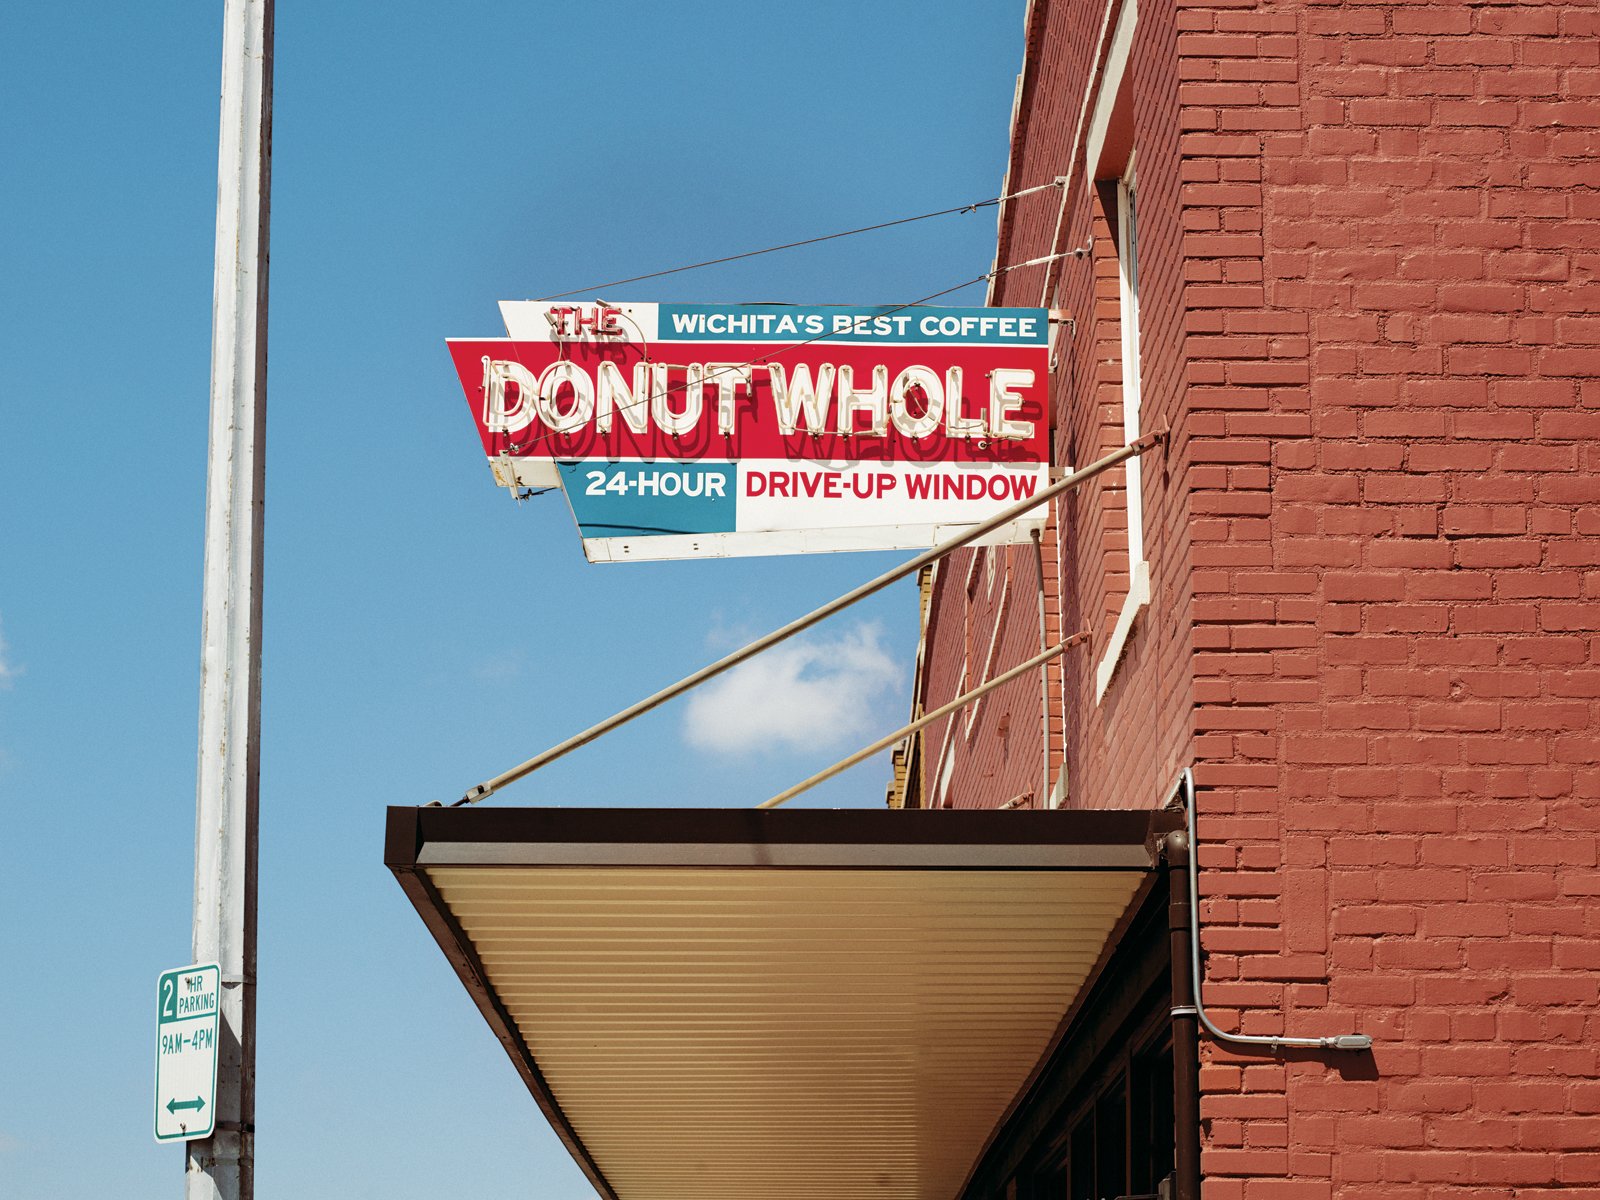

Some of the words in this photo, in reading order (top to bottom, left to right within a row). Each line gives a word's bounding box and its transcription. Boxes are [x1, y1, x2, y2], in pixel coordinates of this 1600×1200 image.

[550, 306, 623, 336] THE
[672, 313, 824, 334] WICHITA'S
[833, 315, 911, 336] BEST
[920, 316, 1038, 337] COFFEE
[483, 360, 752, 435] DONUT
[768, 362, 1036, 439] WHOLE
[585, 471, 726, 497] 24-HOUR
[746, 471, 897, 499] DRIVE-UP
[905, 474, 1038, 501] WINDOW
[189, 975, 203, 992] HR
[163, 979, 174, 1017] 2
[179, 992, 215, 1014] PARKING
